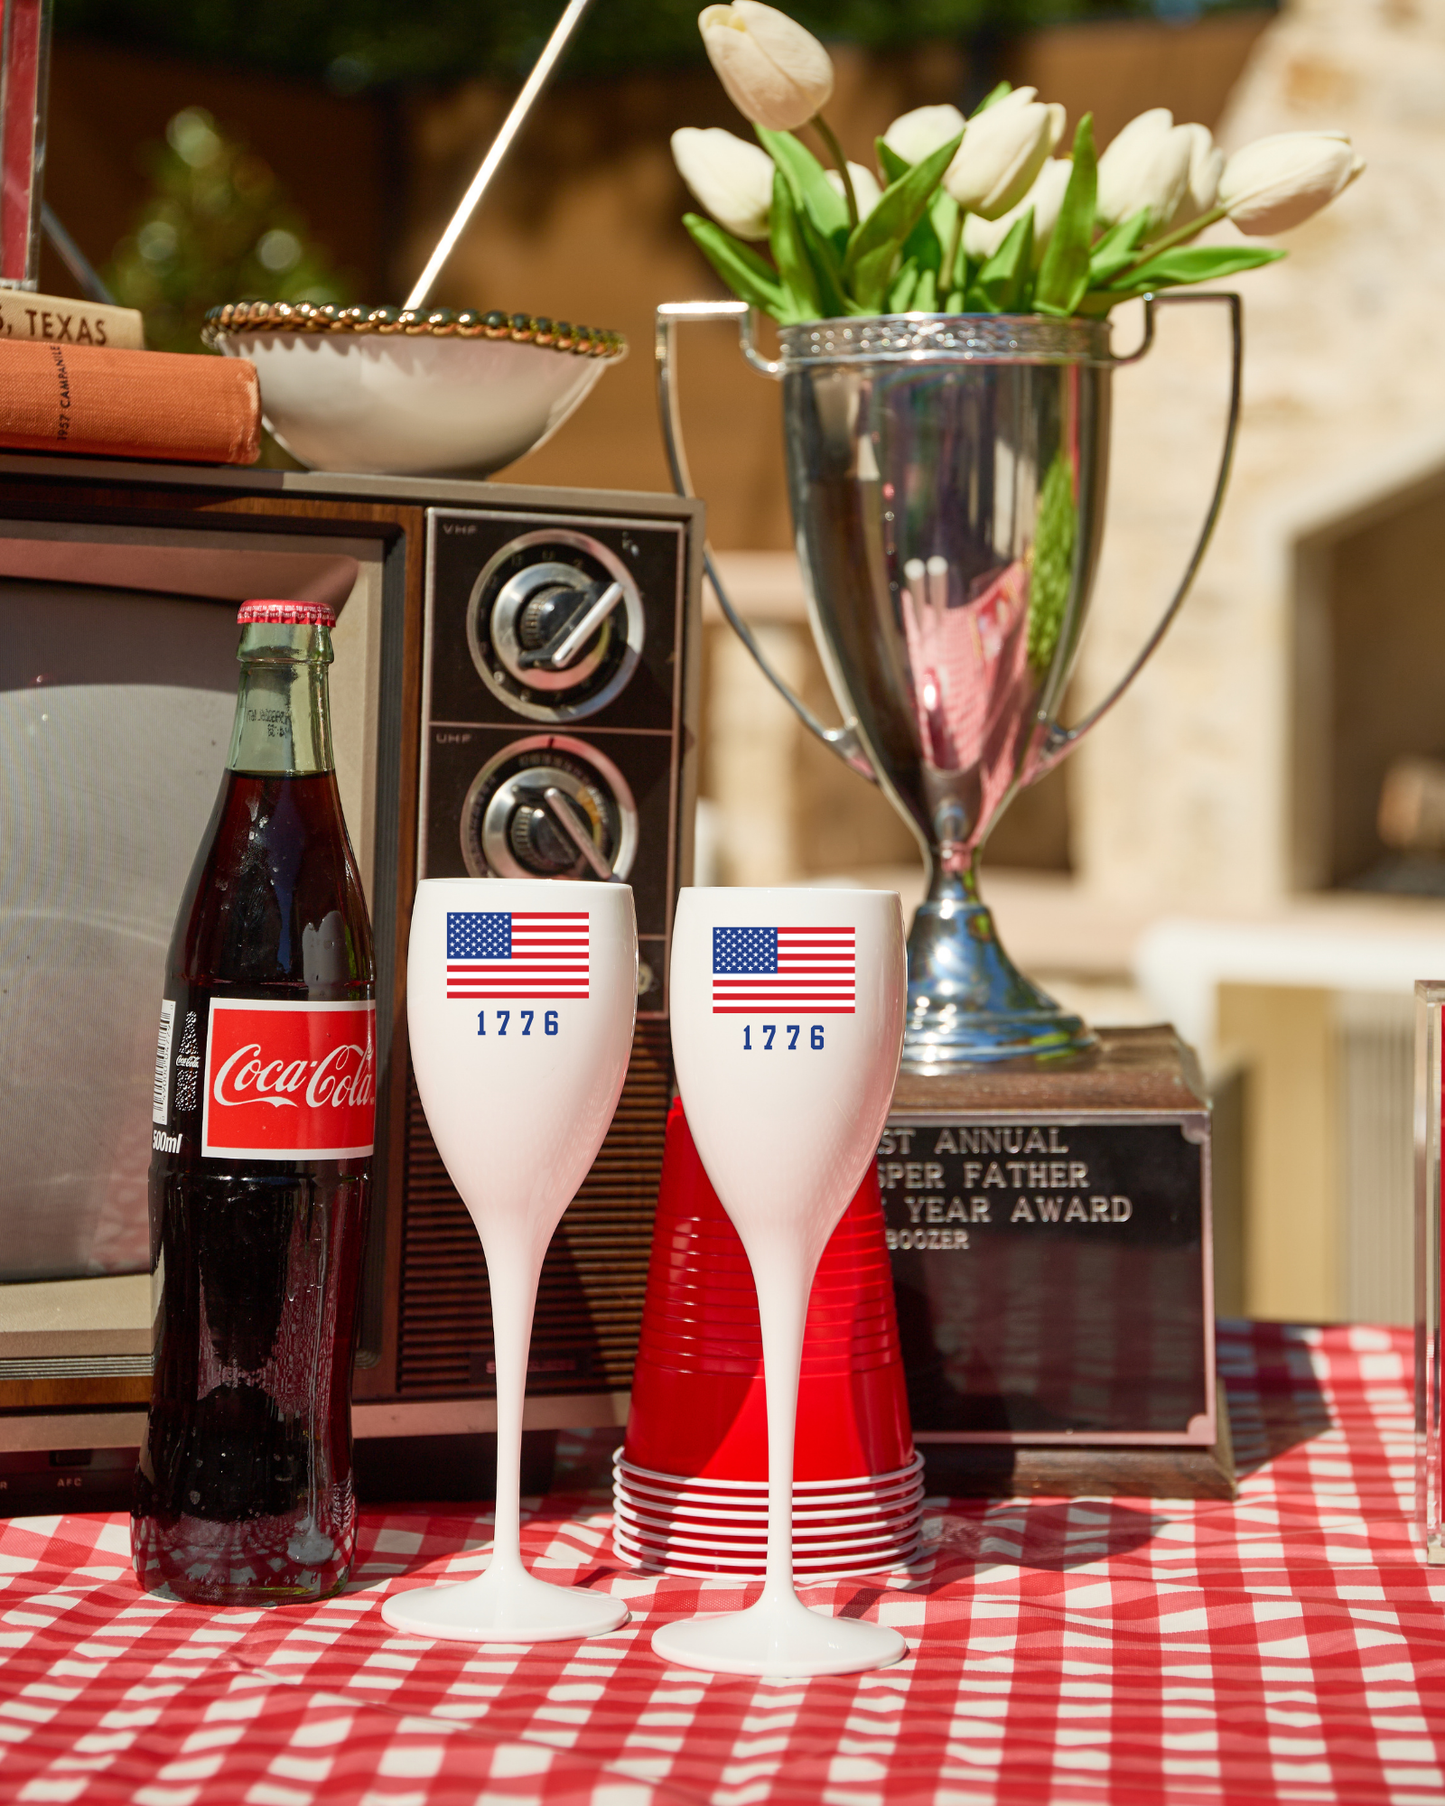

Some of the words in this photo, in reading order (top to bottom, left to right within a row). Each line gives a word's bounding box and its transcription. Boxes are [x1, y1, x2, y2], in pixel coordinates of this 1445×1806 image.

[24, 308, 108, 346] TEXAS
[49, 345, 71, 409] CAMPANILE
[55, 414, 70, 441] 1957
[442, 523, 478, 537] VHF
[435, 732, 473, 745] UHF
[477, 1010, 560, 1036] 1776
[743, 1024, 826, 1051] 1776
[213, 1043, 375, 1109] Coca-Cola
[152, 1129, 183, 1154] 500ml
[934, 1127, 1070, 1155] ANNUAL
[963, 1161, 1091, 1189] FATHER
[905, 1196, 993, 1224] YEAR
[1009, 1195, 1135, 1224] AWARD
[885, 1228, 972, 1251] BOOZER
[57, 1477, 83, 1488] AFC
